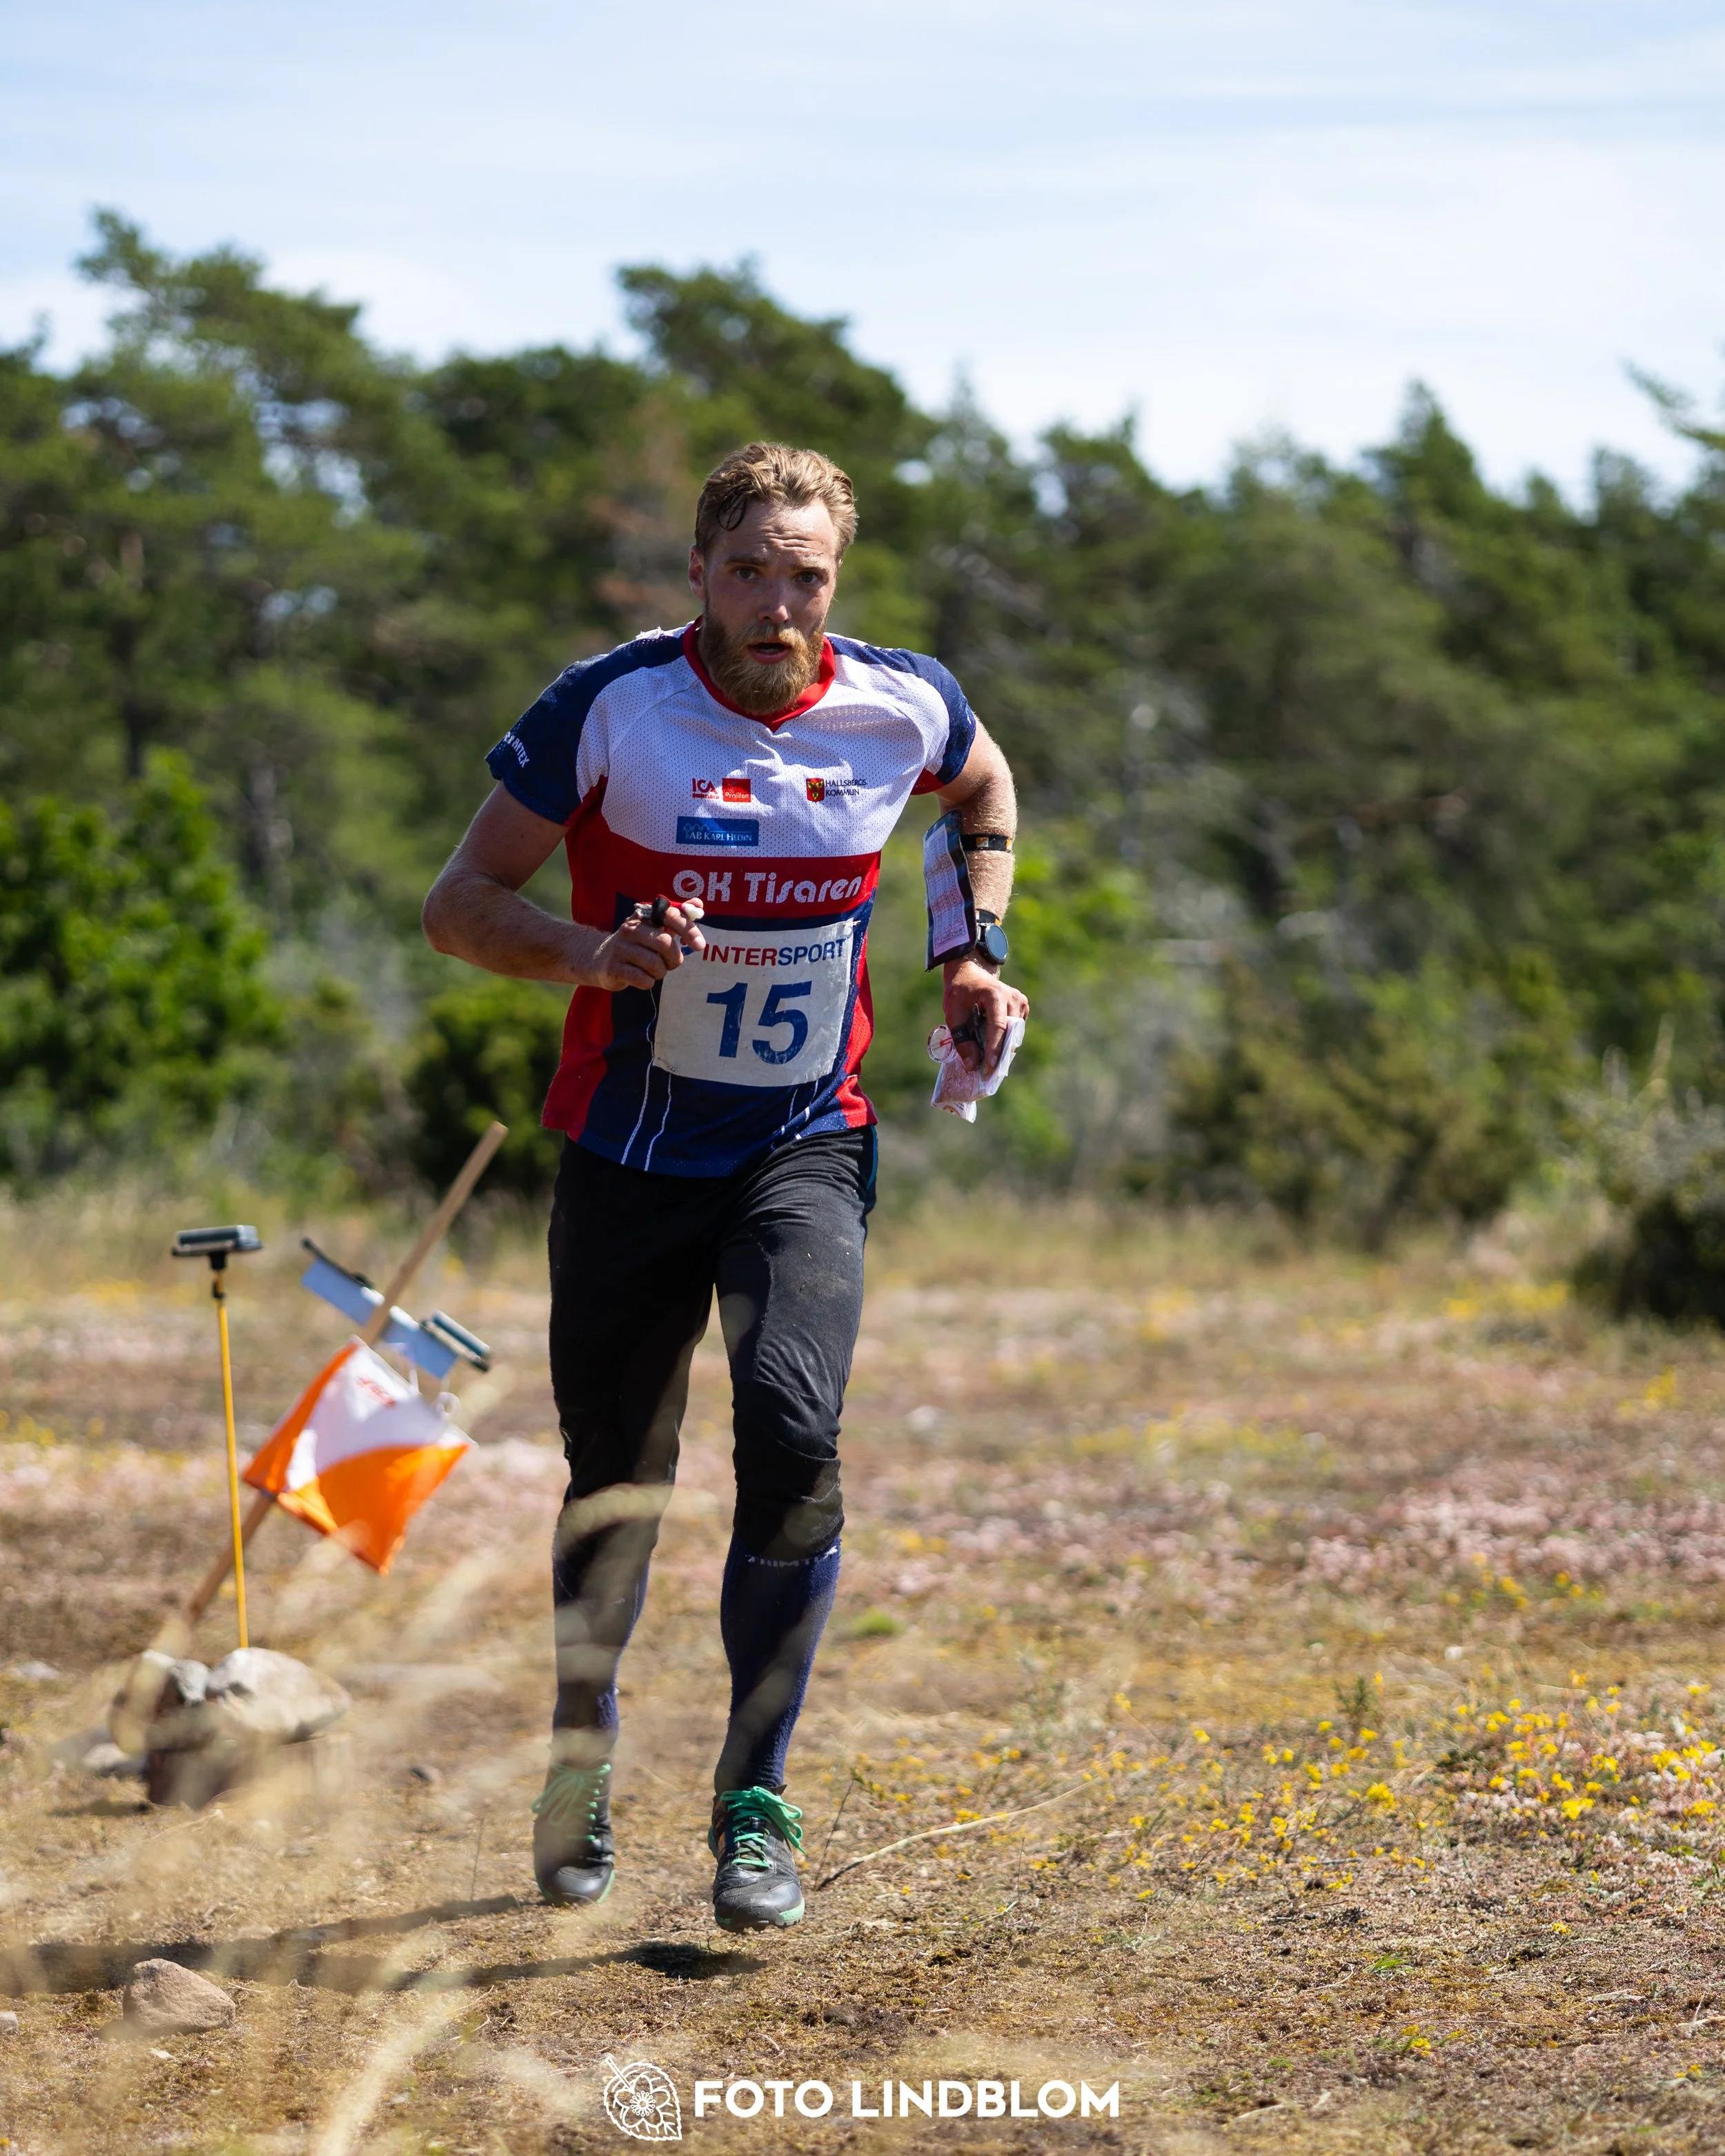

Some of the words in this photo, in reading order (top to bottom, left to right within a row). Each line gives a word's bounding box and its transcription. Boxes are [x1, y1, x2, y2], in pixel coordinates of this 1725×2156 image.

[503, 731, 530, 769] RIMTEX
[692, 778, 718, 793] ICA
[825, 778, 867, 787] HALLSBERGS
[689, 831, 702, 840] AB
[673, 870, 732, 902] OK
[745, 872, 862, 904] Tisaren
[702, 938, 847, 967] INTERSPORT
[706, 980, 813, 1065] 15
